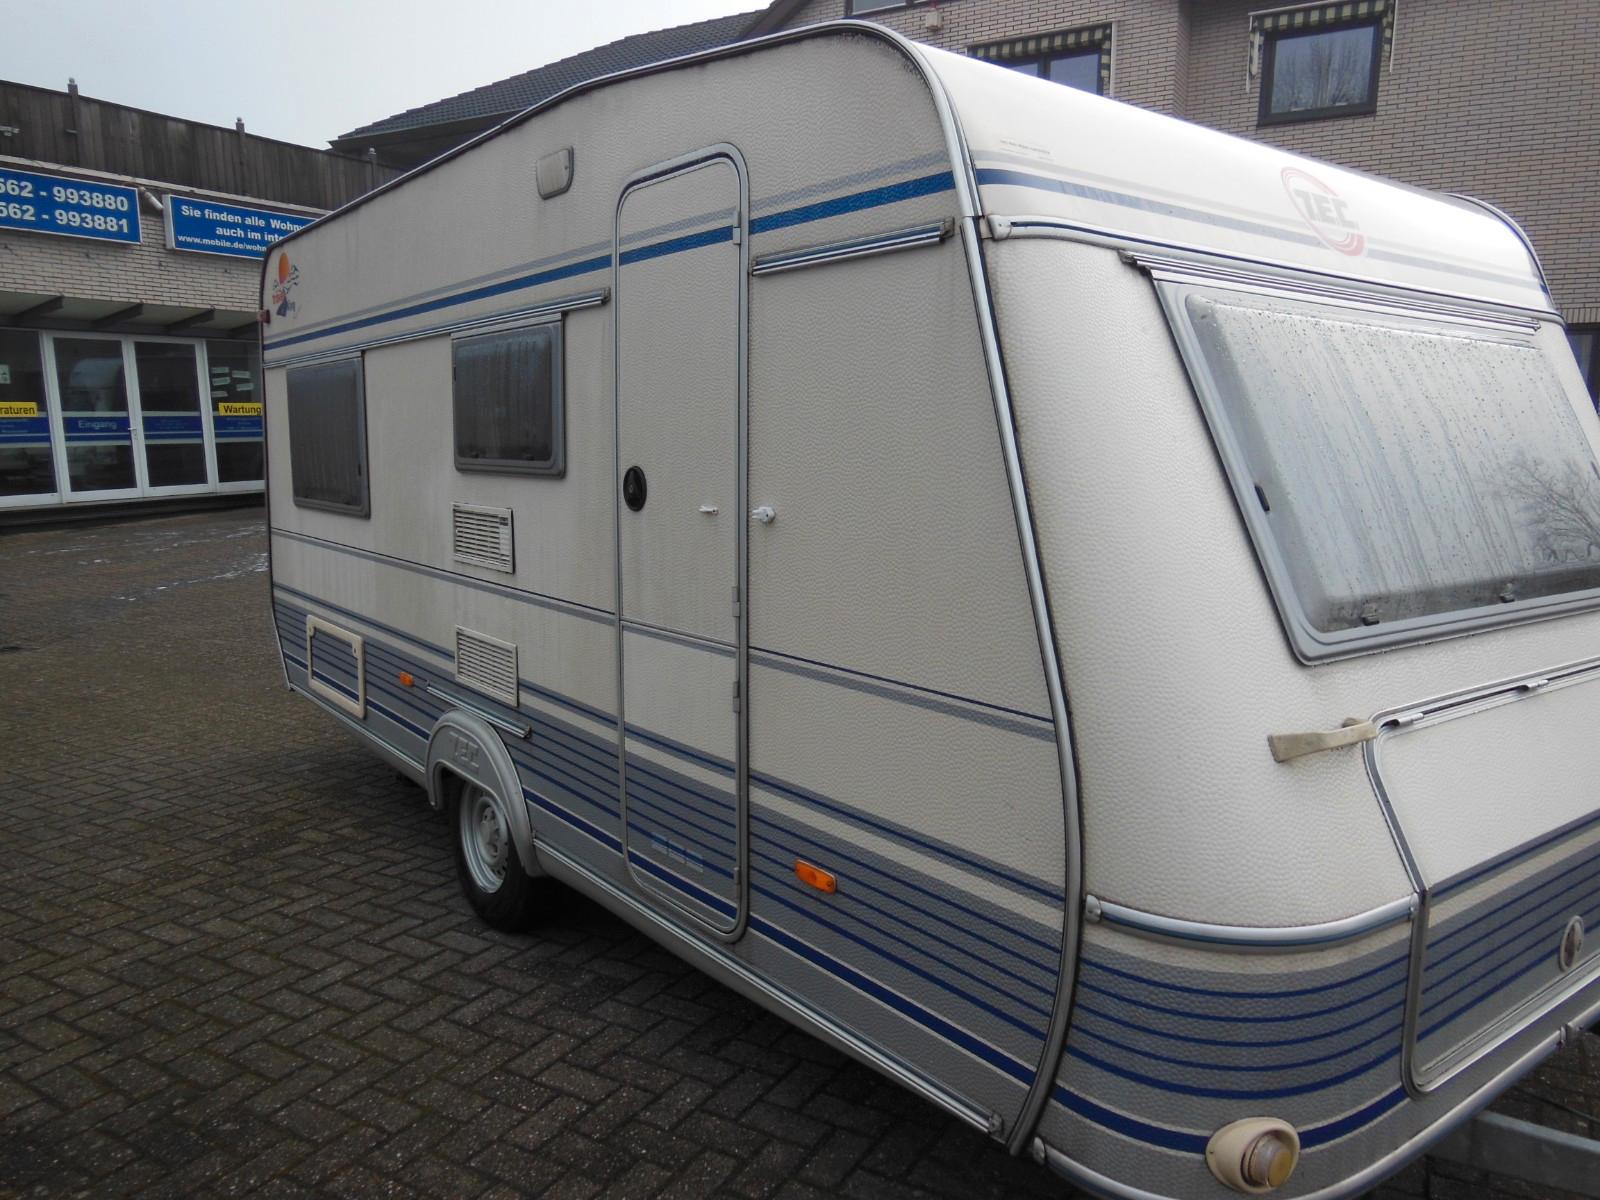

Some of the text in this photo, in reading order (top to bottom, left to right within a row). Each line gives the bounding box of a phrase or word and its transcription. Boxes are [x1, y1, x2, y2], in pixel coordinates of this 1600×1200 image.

[53, 186, 129, 211] 993880
[54, 209, 129, 233] 993881
[181, 205, 304, 232] Sie finden alle Wohn
[216, 226, 245, 239] auch
[247, 229, 261, 240] im
[223, 405, 262, 416] Wartung
[78, 420, 117, 431] Eingang
